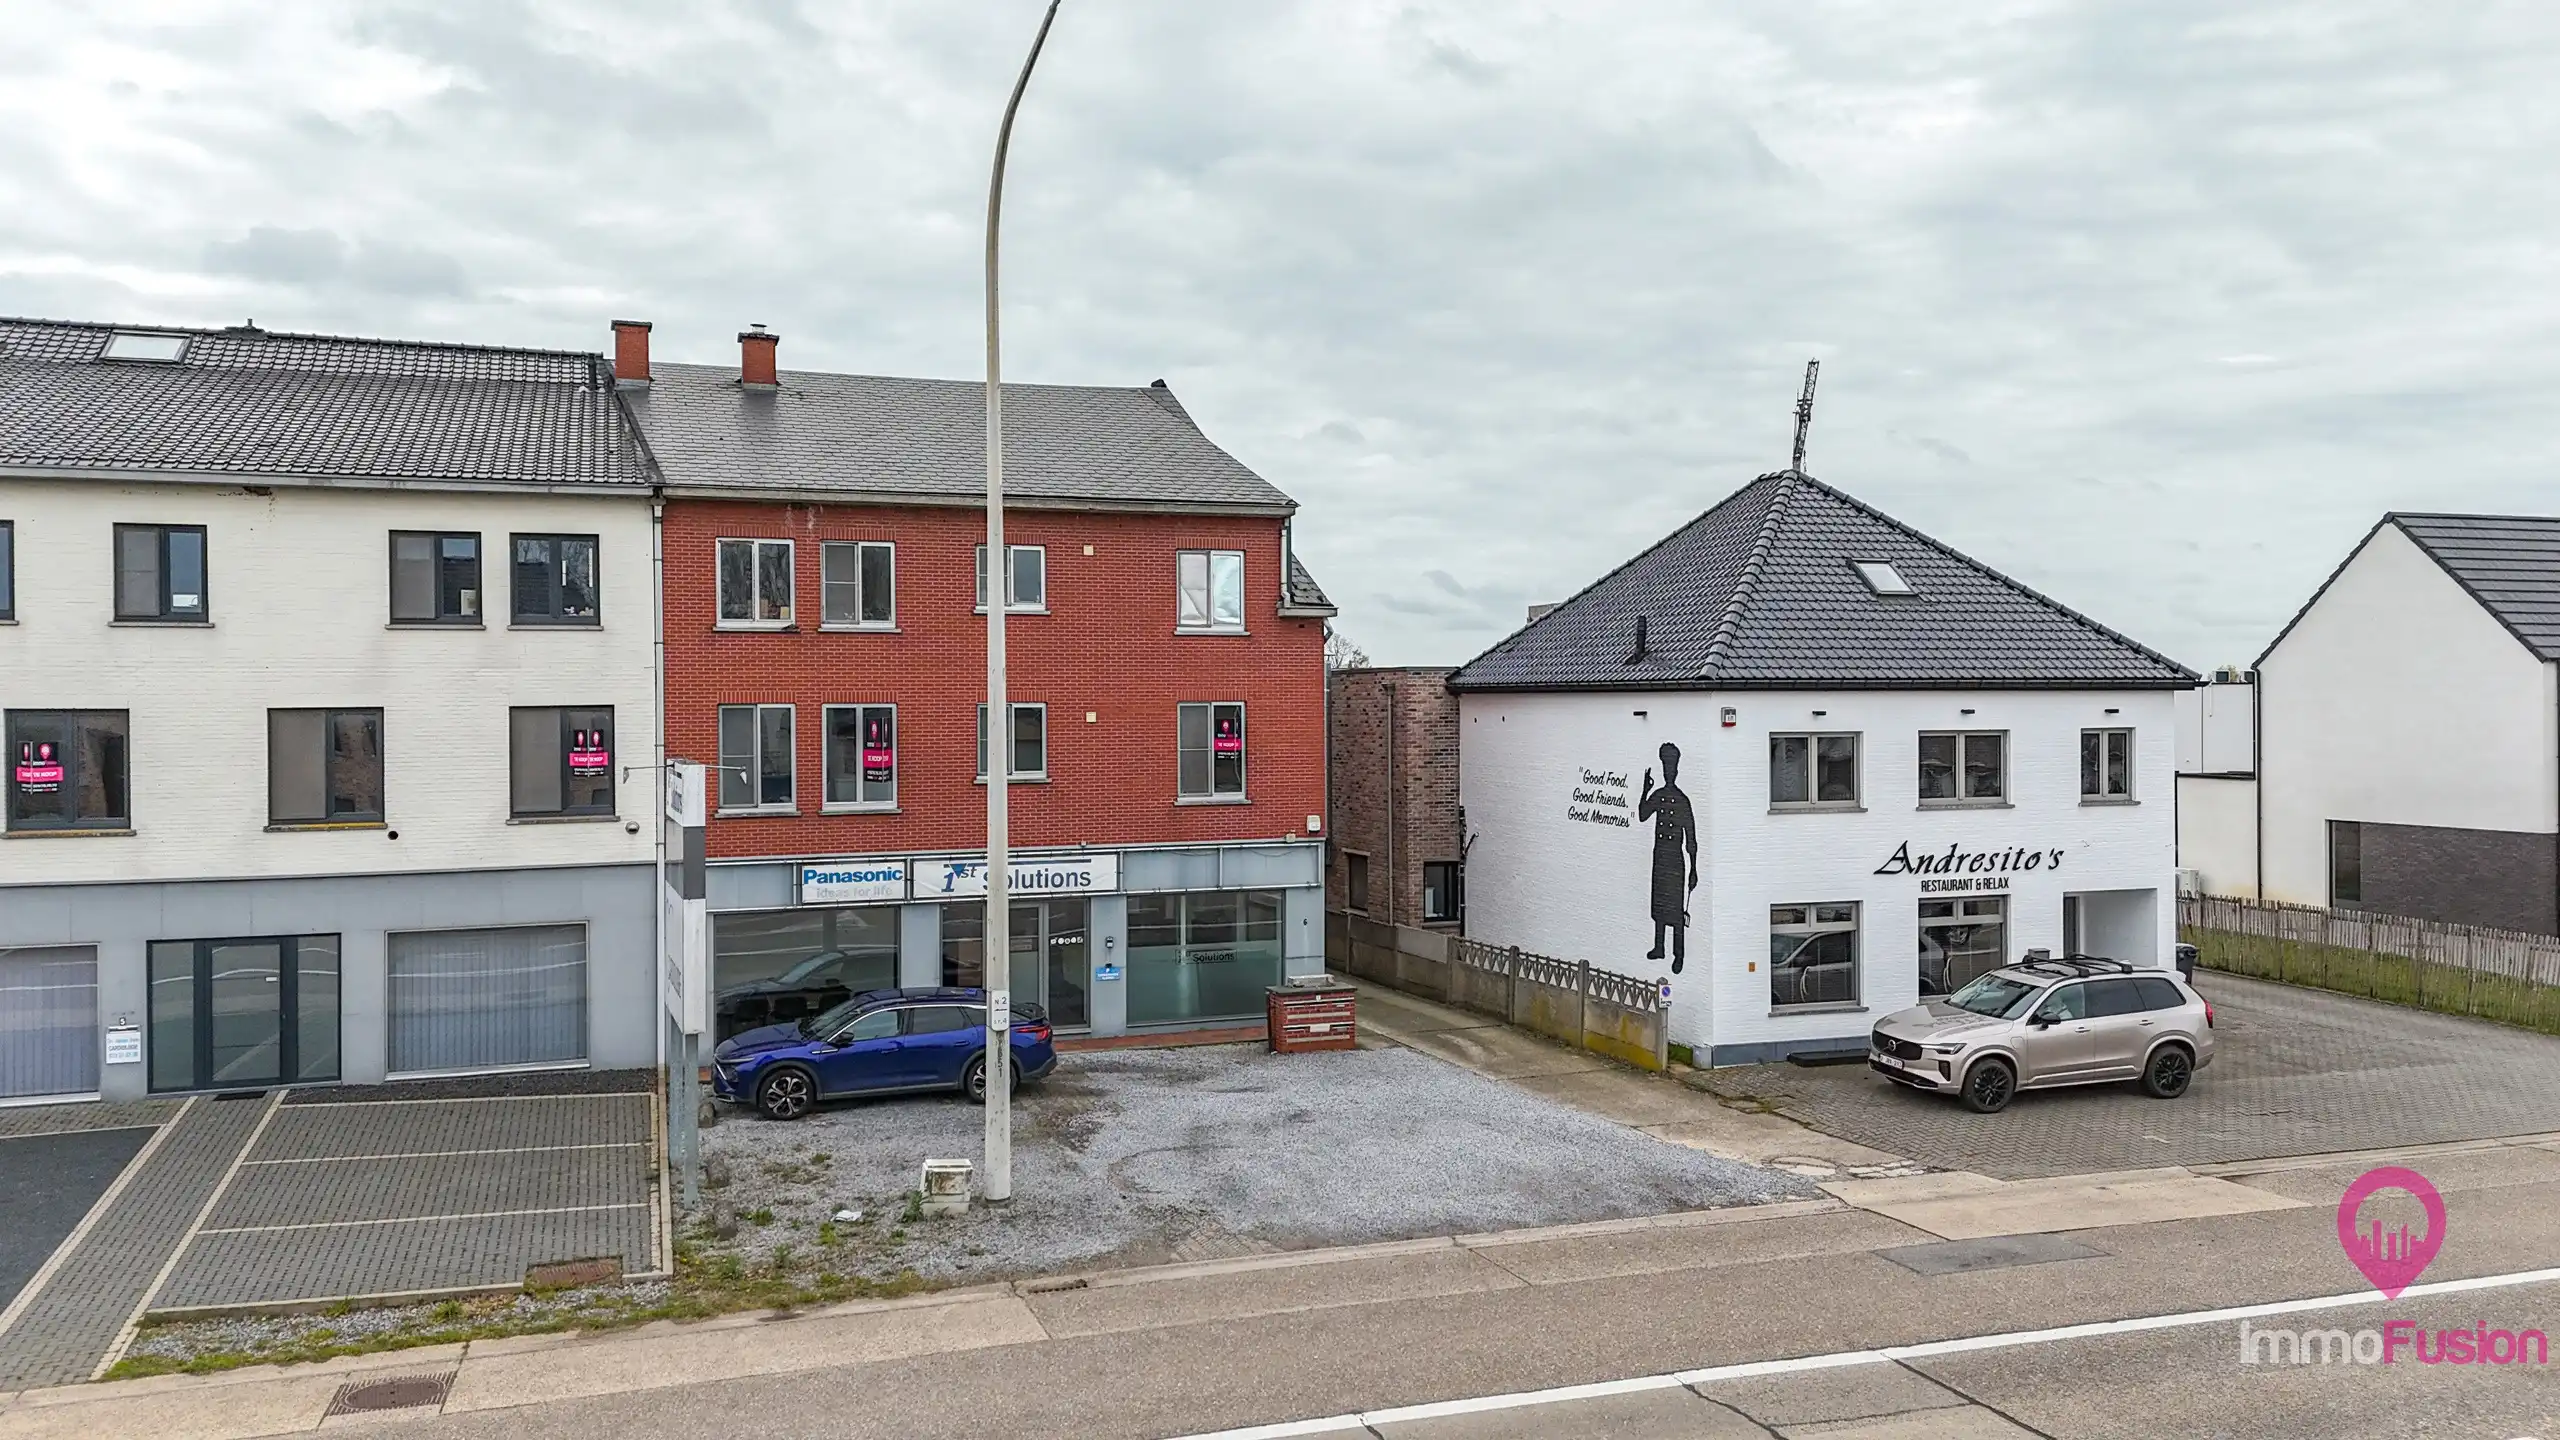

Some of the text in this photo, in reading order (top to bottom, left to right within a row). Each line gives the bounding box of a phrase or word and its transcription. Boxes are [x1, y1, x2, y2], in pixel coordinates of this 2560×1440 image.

[1573, 787, 1595, 803] Good
[1568, 806, 1589, 822] Good
[1873, 840, 2064, 874] Andresito's
[803, 866, 903, 884] Panasonic
[816, 885, 892, 898] ideas for life
[1921, 877, 2010, 892] RESTAURANT & RELAX
